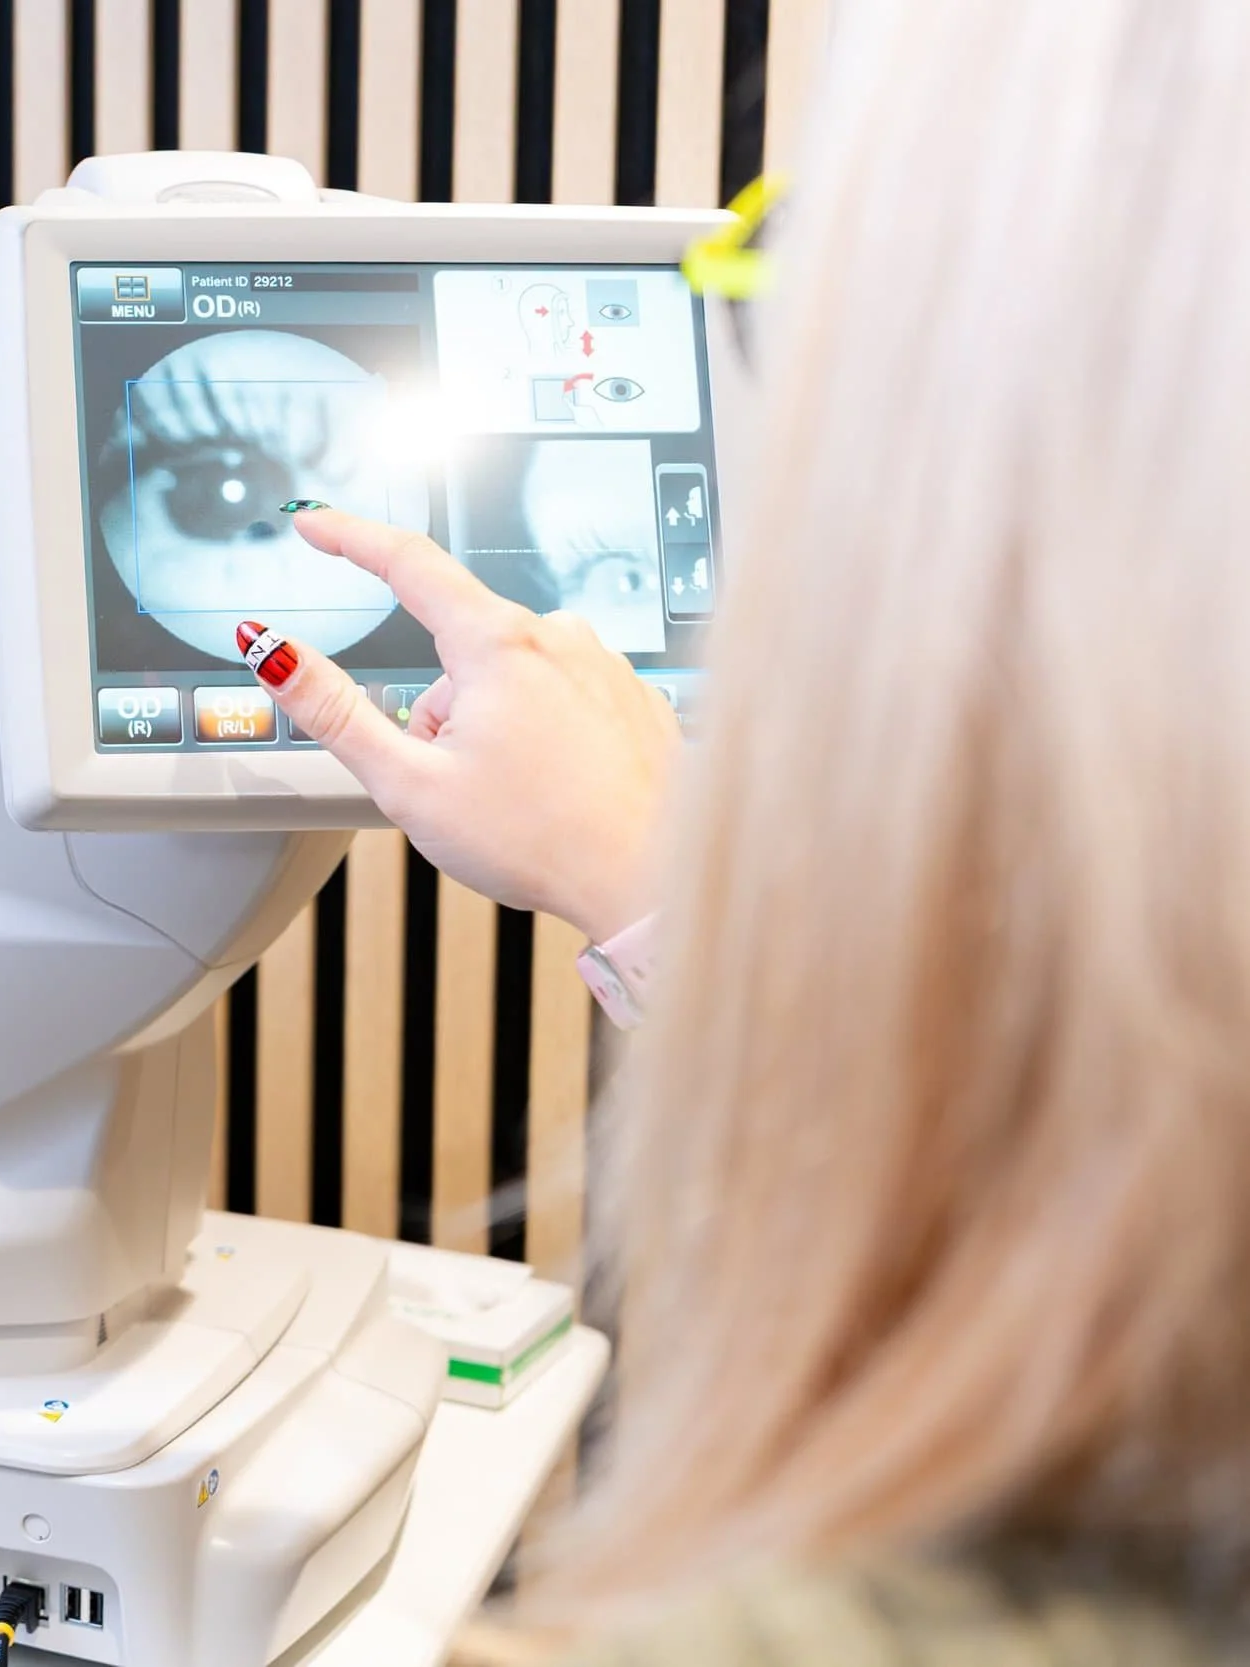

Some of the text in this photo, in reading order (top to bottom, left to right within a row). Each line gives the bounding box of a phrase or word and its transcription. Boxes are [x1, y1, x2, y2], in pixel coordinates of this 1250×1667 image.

[192, 275, 293, 287] Patient ID 29212
[111, 305, 155, 318] MENU
[117, 697, 162, 719] OD
[128, 720, 152, 738] (R)
[217, 720, 256, 738] (R/L)
